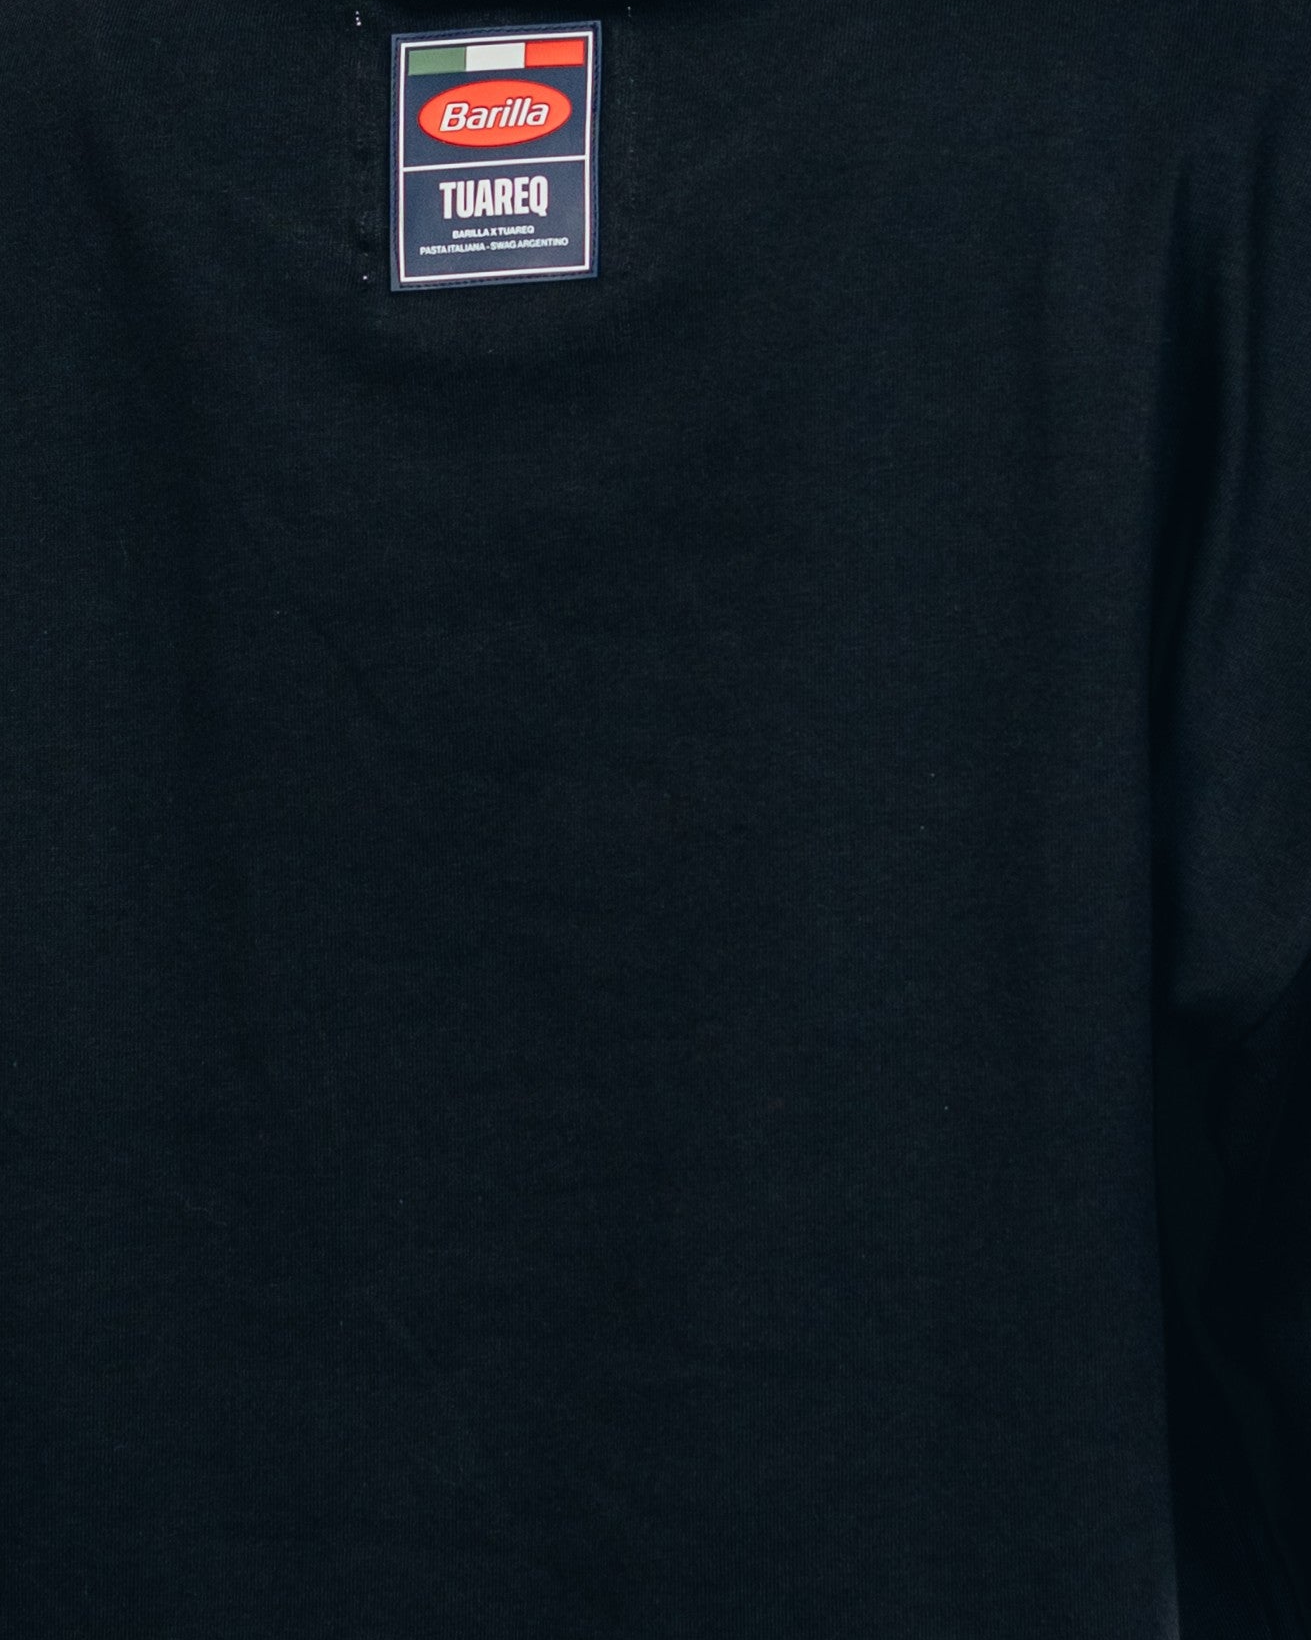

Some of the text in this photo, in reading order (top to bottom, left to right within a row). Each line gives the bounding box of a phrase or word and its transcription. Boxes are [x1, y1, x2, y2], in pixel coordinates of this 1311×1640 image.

[440, 97, 549, 132] Barilla
[439, 175, 548, 219] TUAREQ
[452, 225, 534, 239] BARILLA X TUAREQ
[420, 243, 447, 255] PASTA
[447, 242, 485, 253] ITALIANA
[490, 240, 516, 251] SWAG
[517, 237, 569, 249] ARGENTINO
